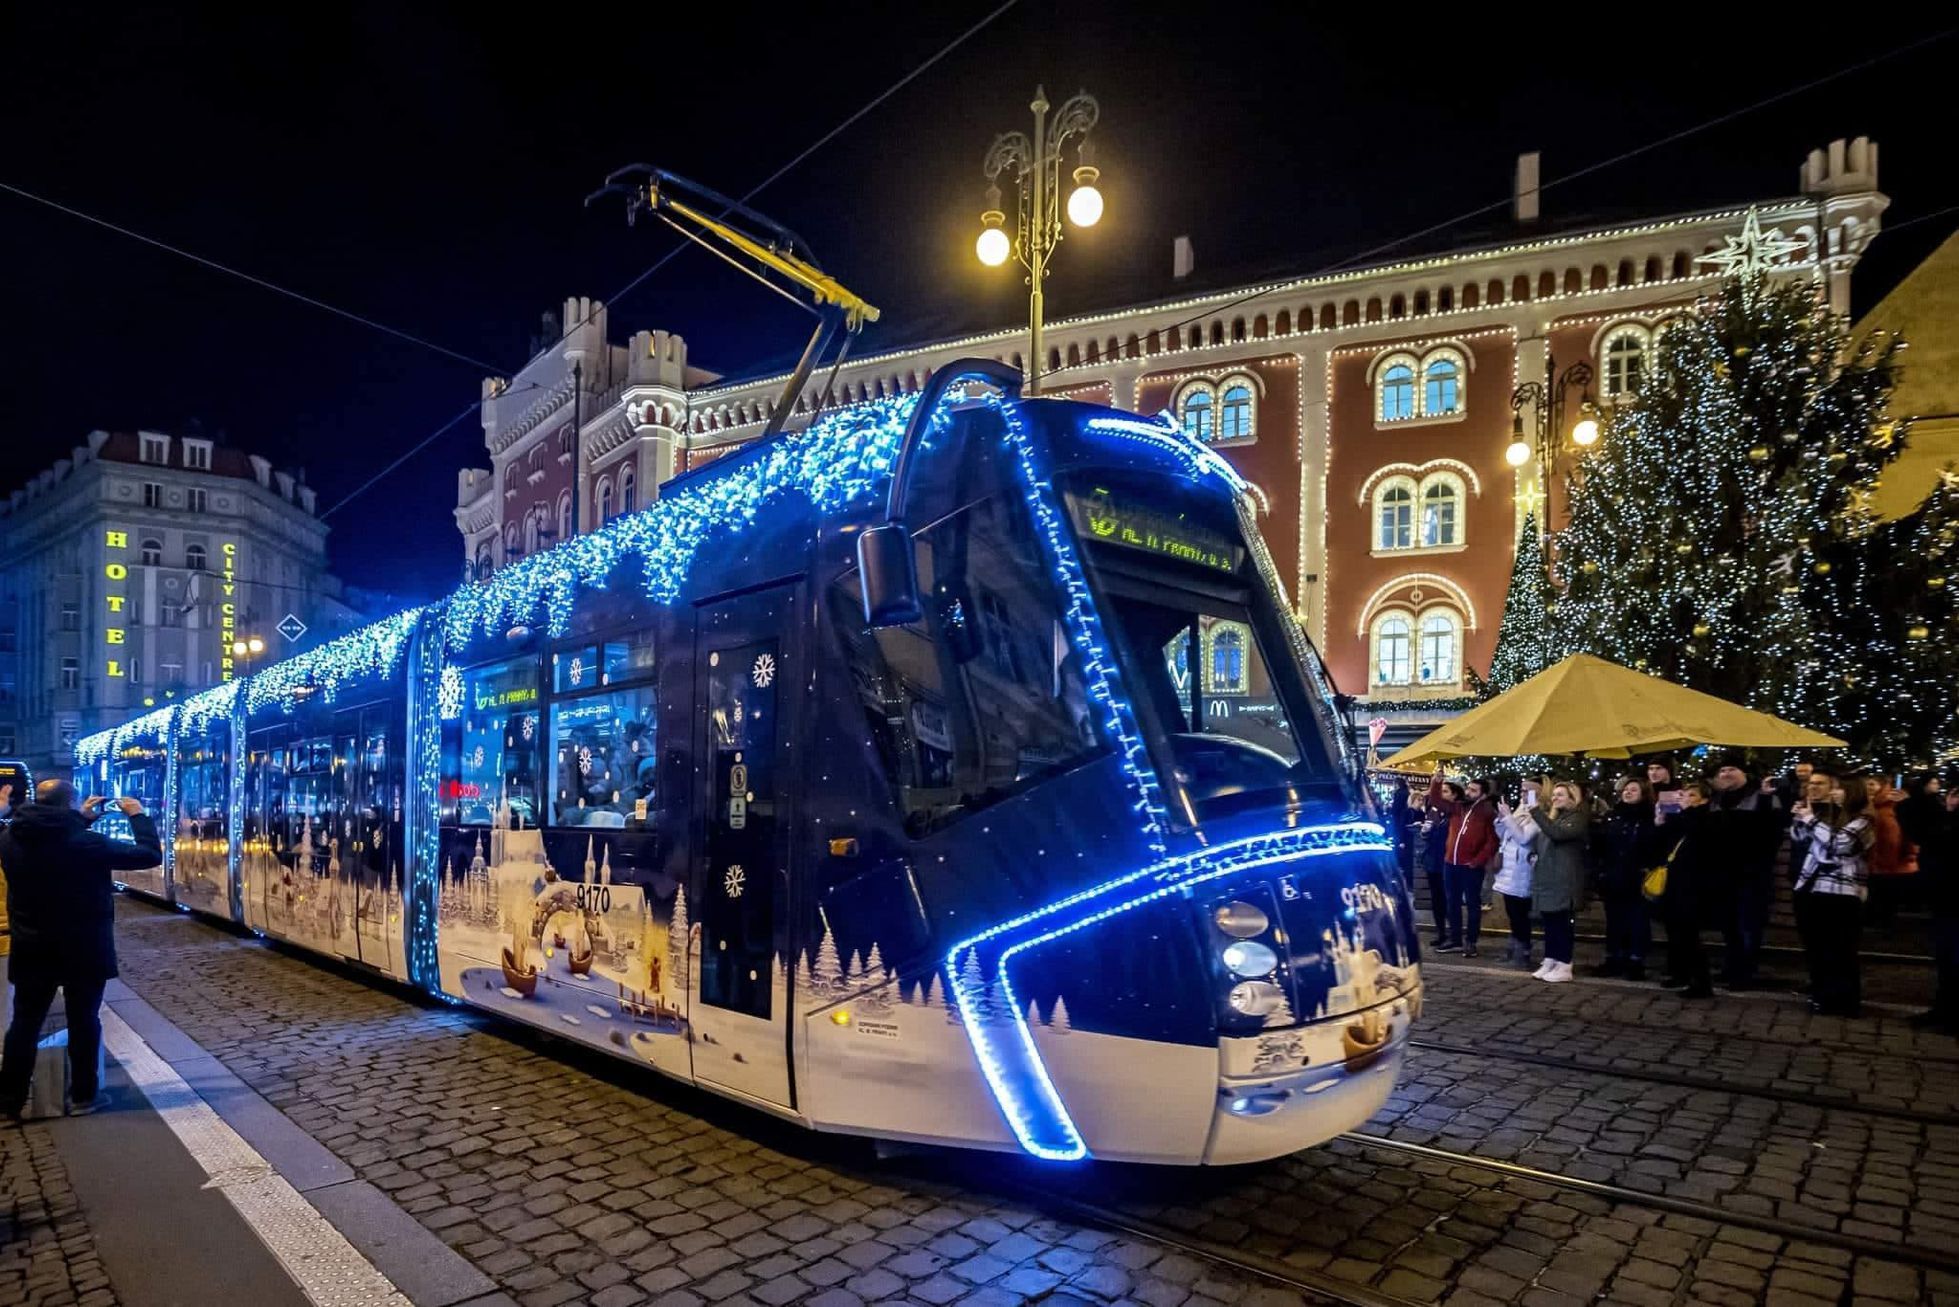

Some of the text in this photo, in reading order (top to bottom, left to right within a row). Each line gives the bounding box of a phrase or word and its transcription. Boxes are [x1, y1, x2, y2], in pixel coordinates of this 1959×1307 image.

[106, 531, 128, 677] HOTEL
[222, 544, 235, 682] CITY CENTRE
[577, 885, 611, 913] 9170
